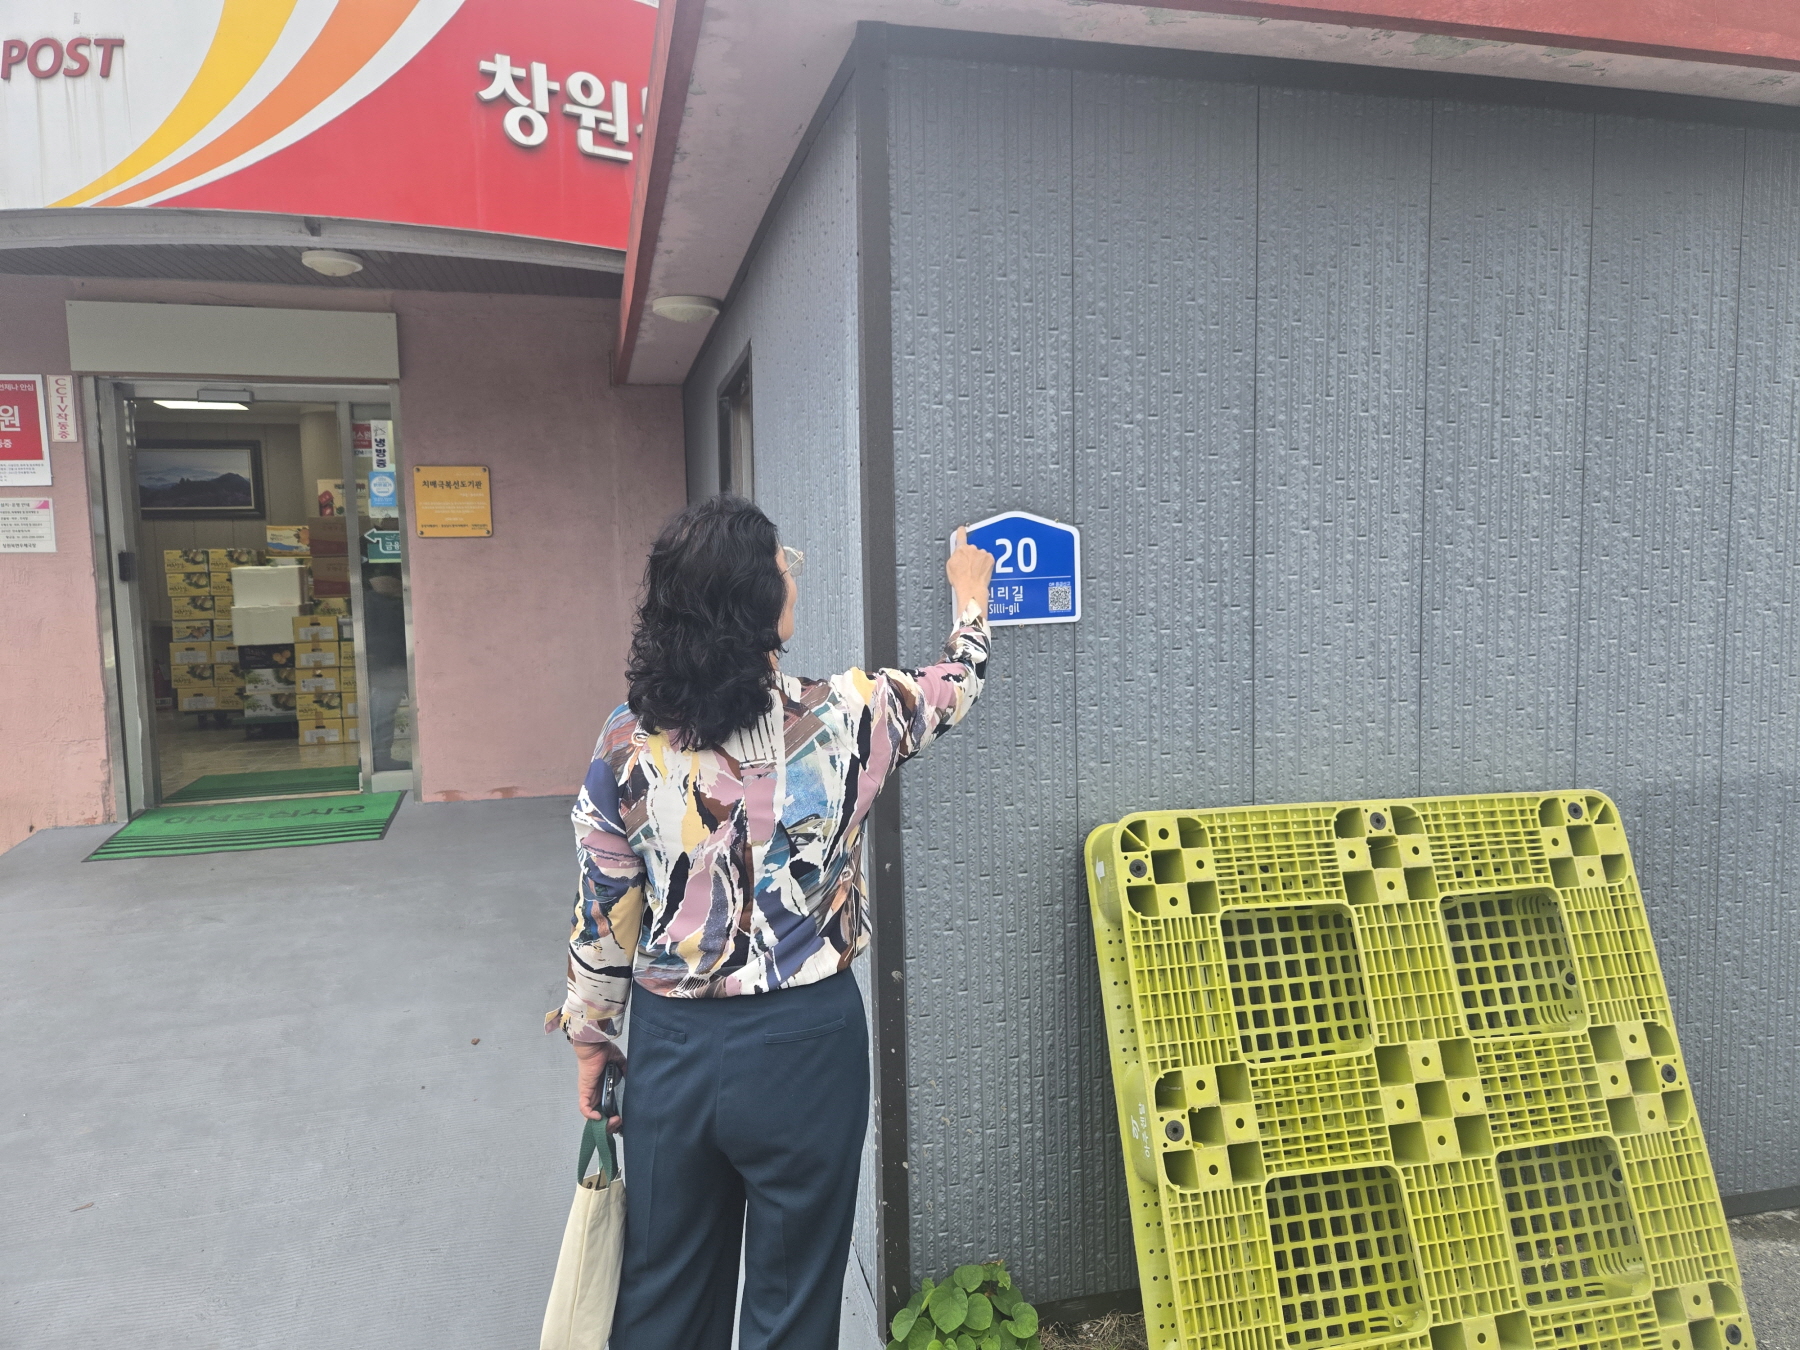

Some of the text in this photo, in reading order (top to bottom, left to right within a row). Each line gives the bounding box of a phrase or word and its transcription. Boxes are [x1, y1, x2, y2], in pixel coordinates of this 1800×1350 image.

[0, 37, 124, 80] POST
[476, 53, 648, 163] 창원
[374, 437, 387, 469] 냉방중
[422, 480, 483, 490] 치매극복선도기관
[995, 537, 1038, 574] 20
[988, 602, 1020, 616] Silli-gil
